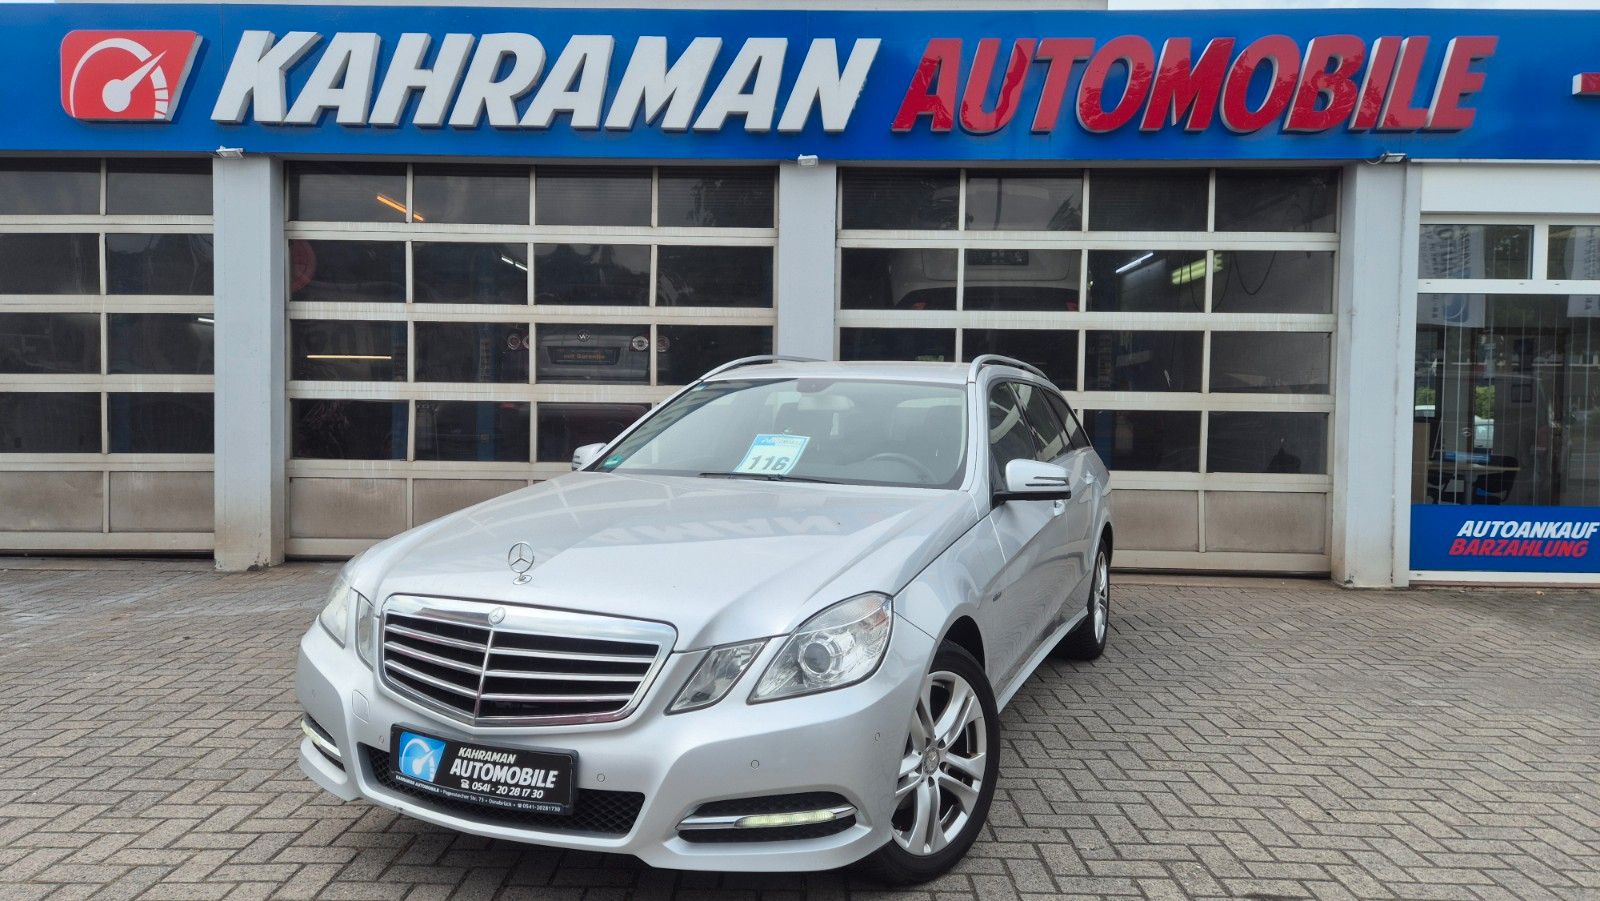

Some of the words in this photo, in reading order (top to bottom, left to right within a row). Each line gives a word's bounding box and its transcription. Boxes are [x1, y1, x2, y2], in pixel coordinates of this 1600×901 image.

[211, 30, 882, 133] KAHRAMAN
[892, 34, 1500, 134] AUTOMOBILE
[748, 455, 790, 470] 116
[1457, 520, 1600, 539] AUTOANKAUF
[1449, 539, 1588, 557] BARZAHLUNG
[458, 747, 516, 763] KAHRAMAN
[450, 759, 558, 788] AUTOMOBILE
[471, 782, 491, 792] 0541
[496, 786, 507, 794] 20
[508, 787, 520, 796] 28
[521, 788, 531, 797] 17
[531, 790, 543, 798] 30
